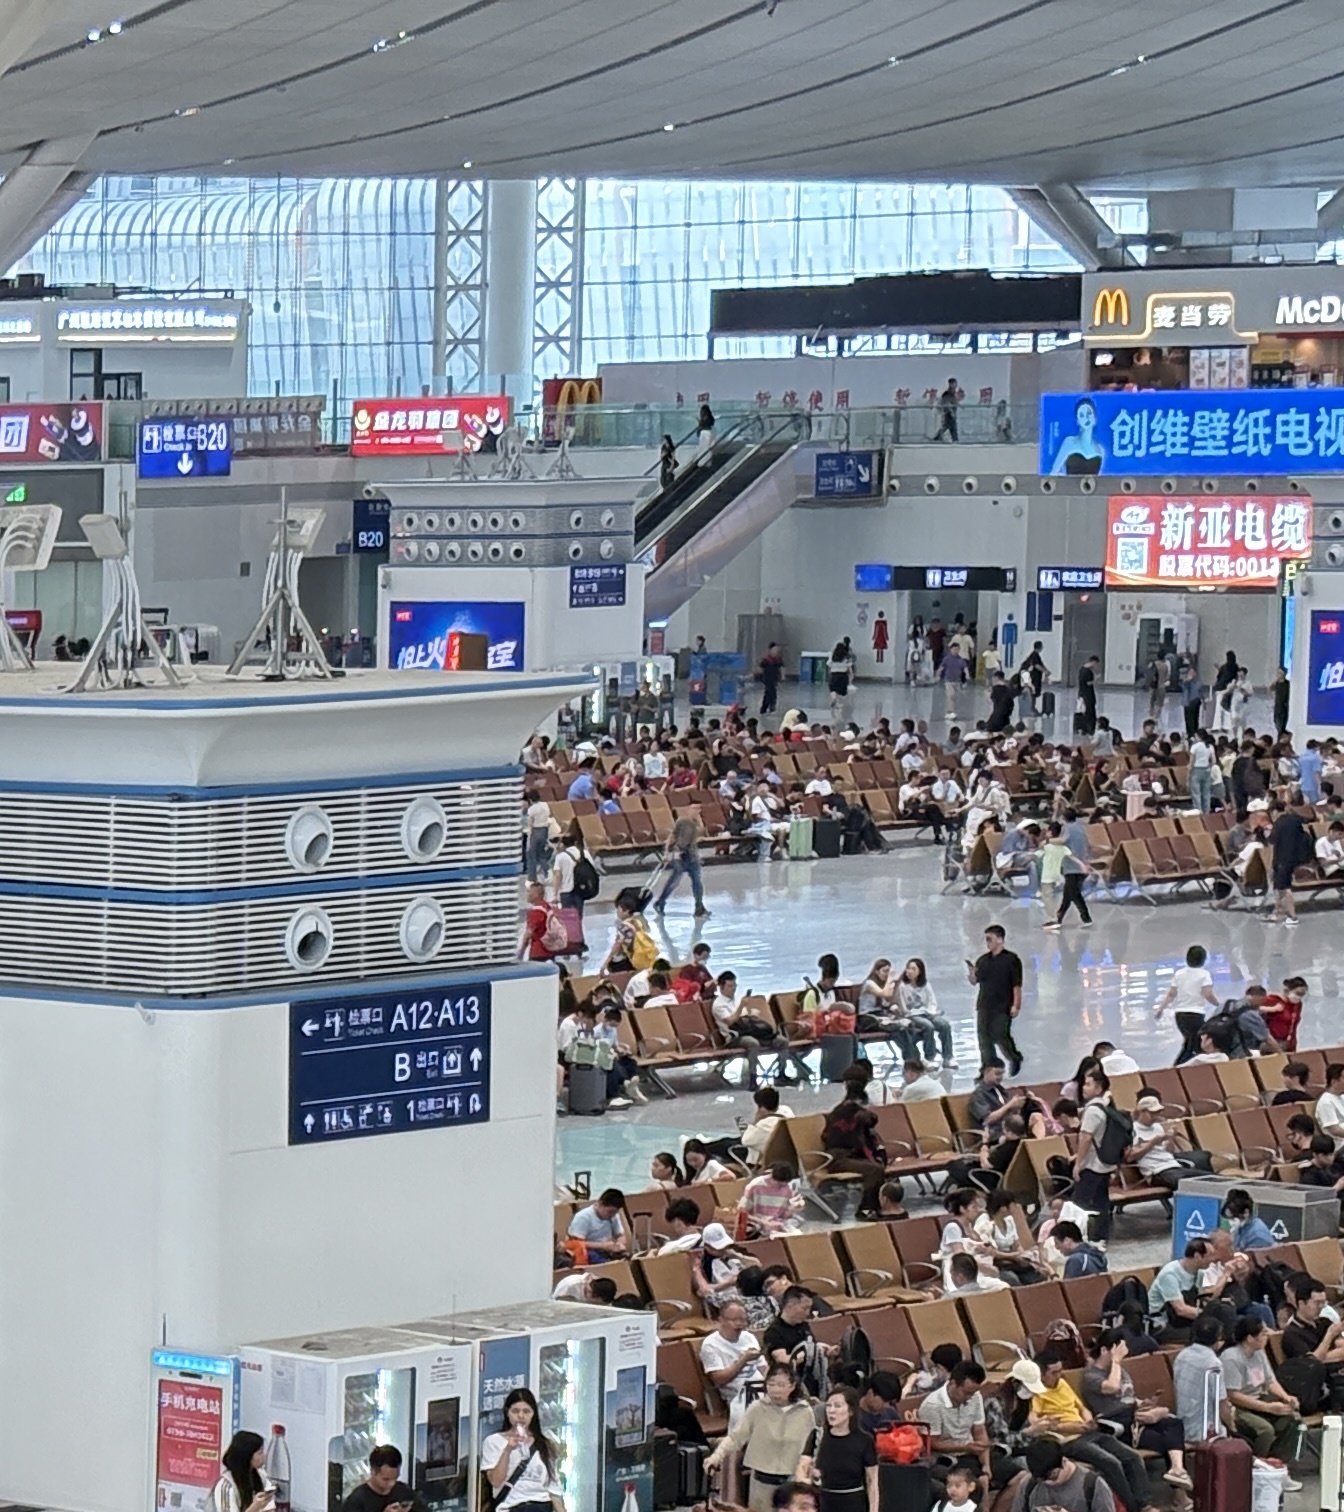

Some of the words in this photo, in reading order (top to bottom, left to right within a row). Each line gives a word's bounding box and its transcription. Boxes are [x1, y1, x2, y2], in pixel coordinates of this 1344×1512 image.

[1152, 303, 1232, 328] 麦当劳
[197, 422, 227, 451] B20
[1159, 501, 1310, 551] 新亚电缆
[358, 531, 384, 548] B20
[348, 1007, 383, 1026] 检票口
[389, 996, 480, 1033] A12·A13
[394, 1052, 411, 1082] B
[416, 1050, 439, 1069] 出口
[406, 1099, 415, 1122] 1
[161, 1391, 221, 1415] 手机充电站
